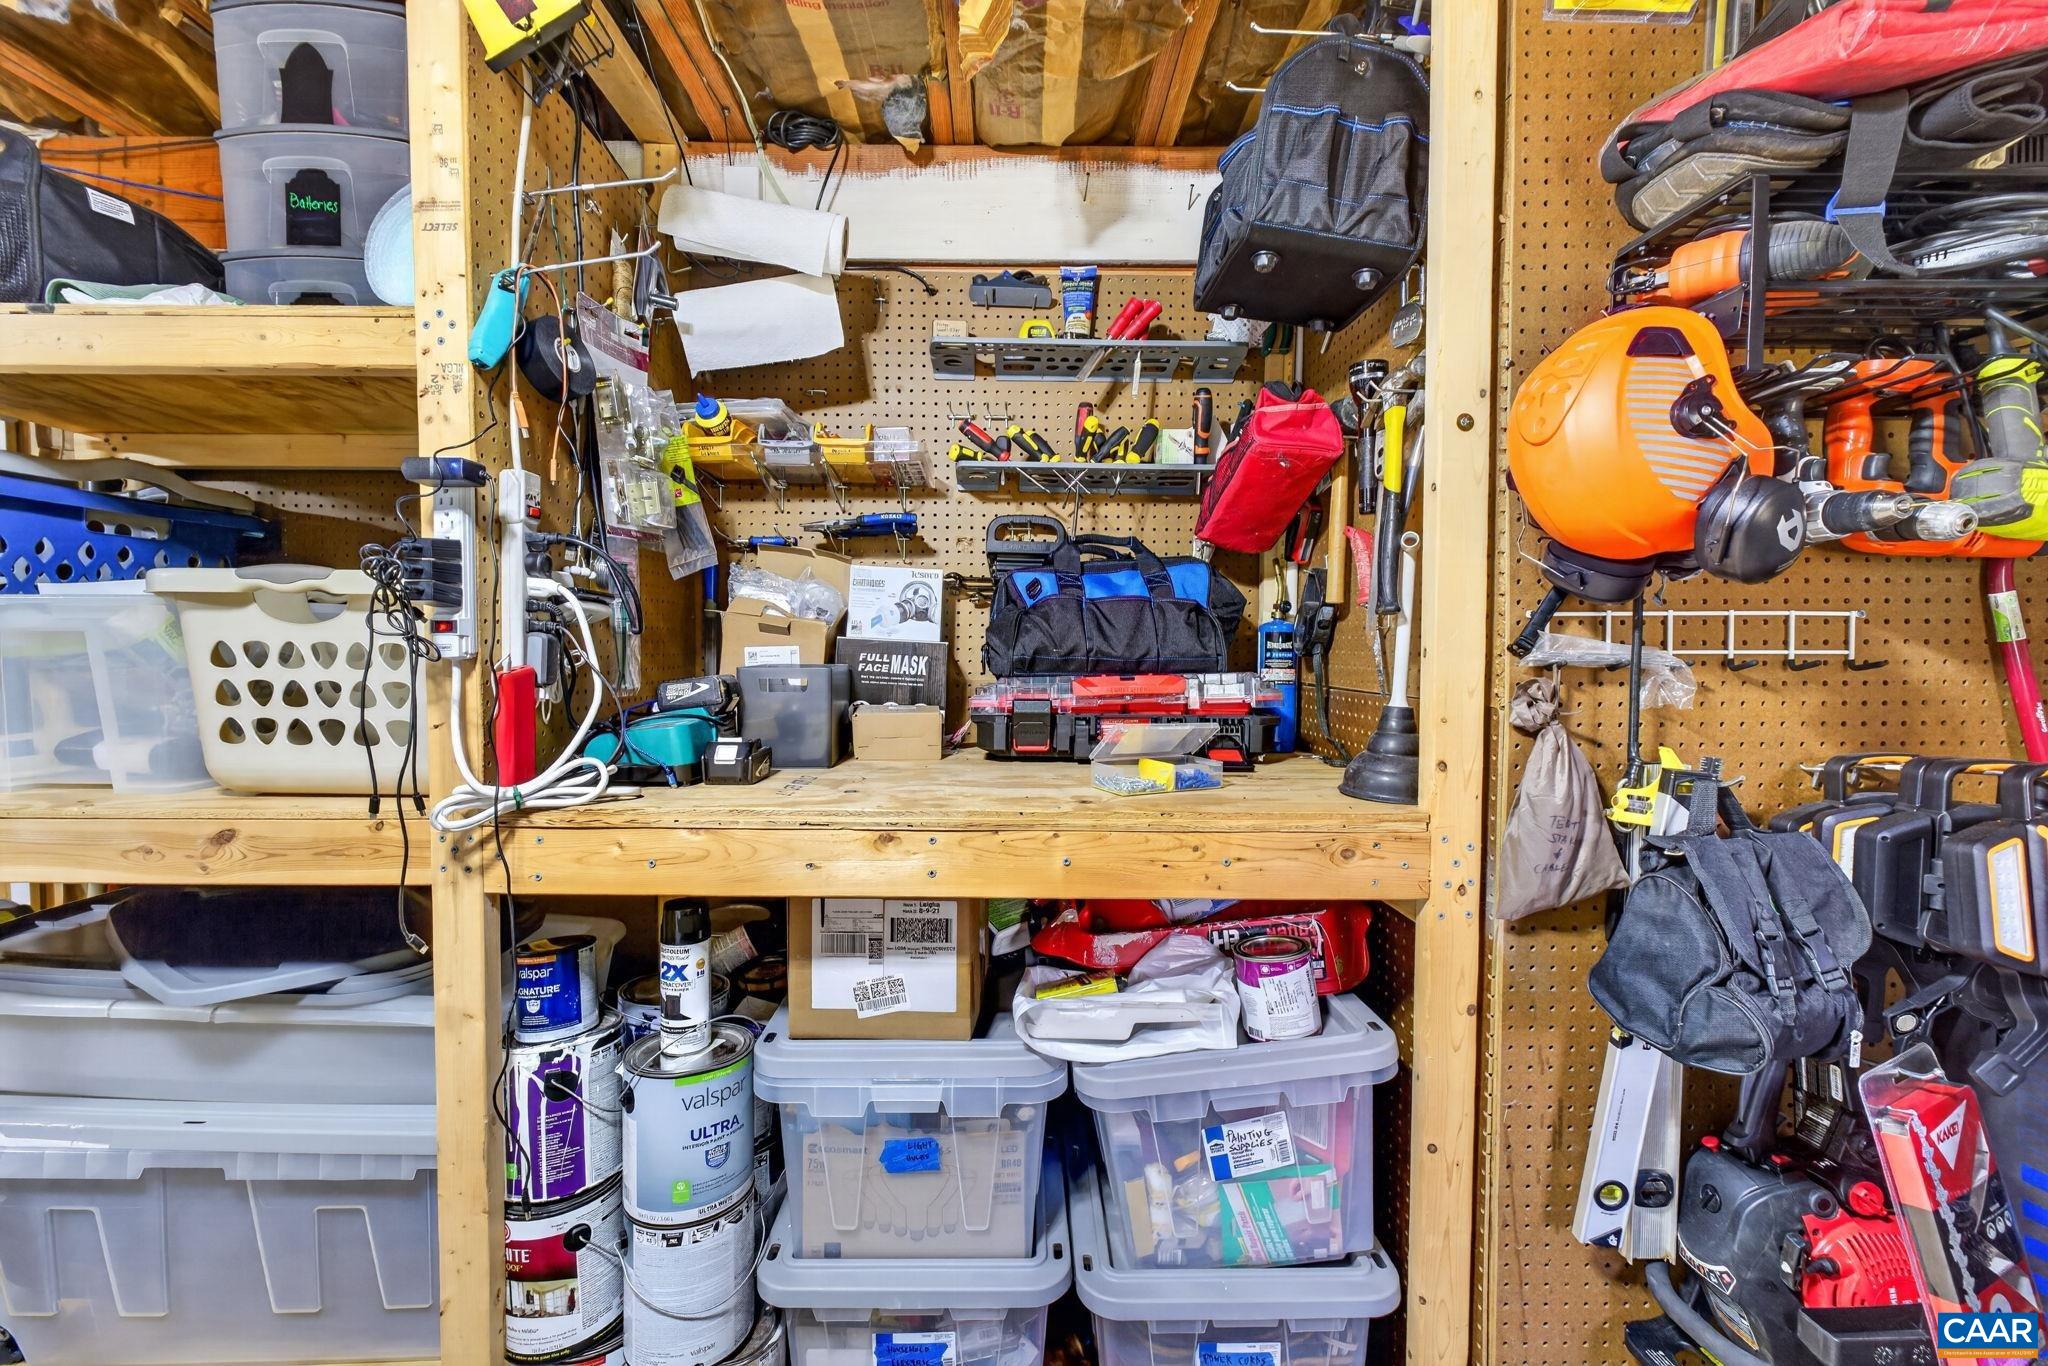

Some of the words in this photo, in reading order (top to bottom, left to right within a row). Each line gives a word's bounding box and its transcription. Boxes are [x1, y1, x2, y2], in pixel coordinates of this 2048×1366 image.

[289, 191, 339, 213] Batteries
[421, 222, 459, 232] SELECT
[859, 652, 890, 662] FULL
[890, 654, 929, 676] MASK
[858, 662, 890, 673] FACE
[661, 960, 689, 982] 2X
[681, 1076, 747, 1111] valspar
[690, 1114, 740, 1141] ULTRA
[1226, 1128, 1273, 1145] PAINTING
[1229, 1138, 1273, 1153] SUPPLIES
[698, 1203, 718, 1215] ULTRA
[506, 1247, 531, 1263] HITE
